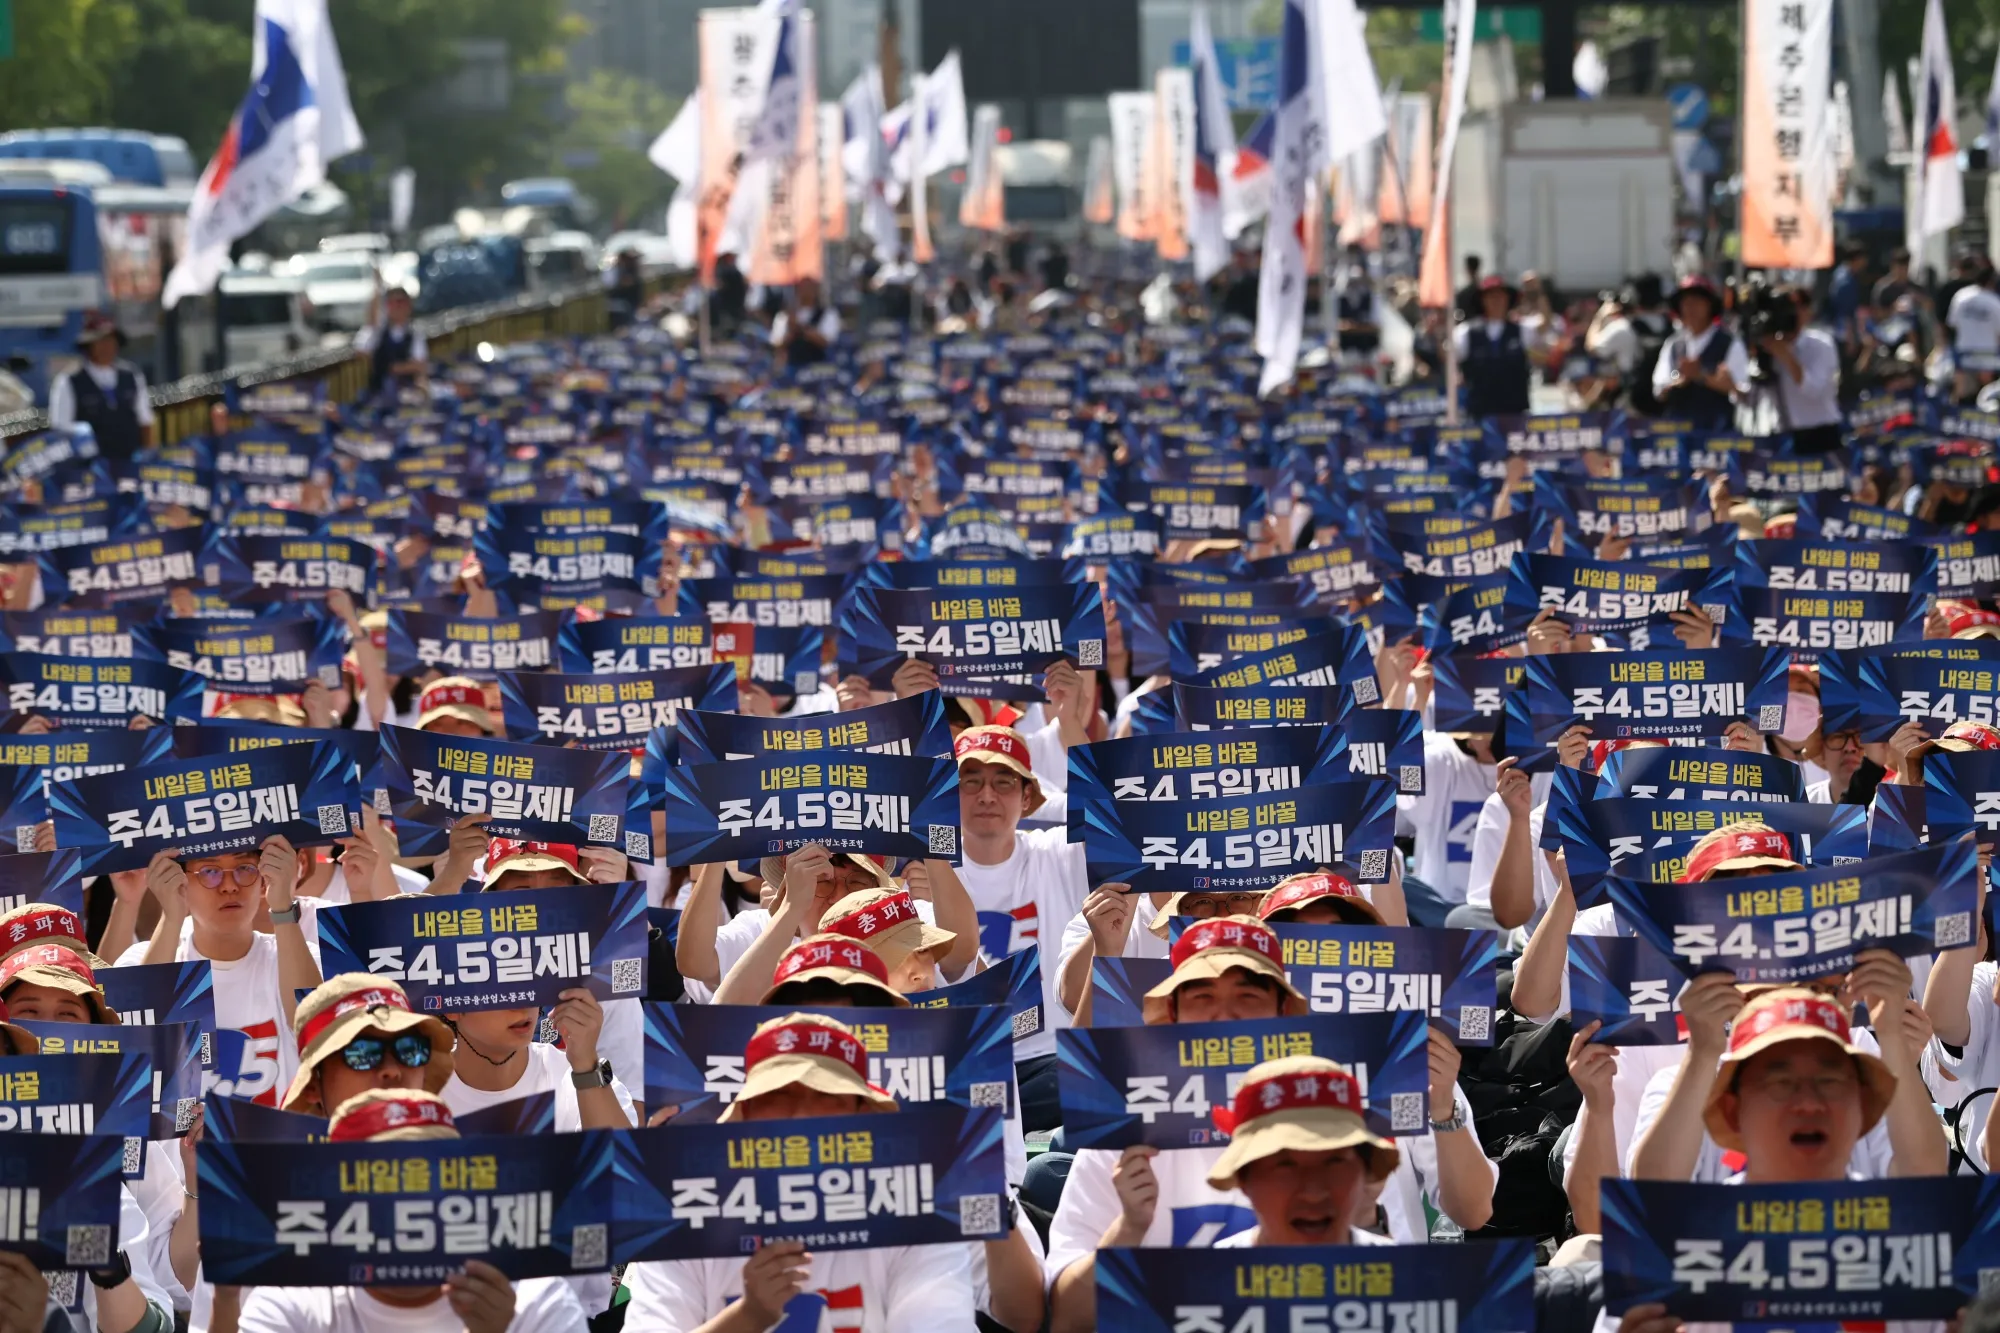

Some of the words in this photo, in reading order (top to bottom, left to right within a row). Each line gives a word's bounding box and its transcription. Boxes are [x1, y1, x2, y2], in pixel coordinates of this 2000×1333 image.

[69, 548, 195, 598] 주4.5일제!
[509, 550, 633, 581] 주4.5일제!
[1802, 550, 1847, 567] 내일을
[1850, 553, 1881, 569] 바꿀
[253, 560, 364, 596] 주4.5일제
[938, 569, 983, 584] 내일을
[987, 569, 1017, 584] 바꿀
[1574, 570, 1621, 589] 내일을
[1624, 576, 1657, 591] 바꿀
[733, 585, 773, 599] 내일을
[1537, 586, 1689, 619] 주4.5일제!
[931, 600, 984, 620] 내일을
[988, 598, 1022, 617] 바꿀
[1784, 600, 1829, 616] 내일을
[1833, 601, 1865, 617] 바꿀
[195, 641, 241, 655] 내일을
[244, 636, 274, 652] 바꿀
[447, 625, 489, 641] 내일을
[493, 624, 521, 639] 바꿀
[622, 627, 669, 644] 내일을
[673, 627, 704, 644] 바꿀
[896, 619, 1062, 658] 주4.5일제!
[1753, 618, 1893, 649] 주4.5일제!
[417, 635, 550, 669] 주4.5일제!
[1264, 654, 1297, 677] 바꿀
[42, 665, 93, 681] 내일을
[98, 667, 132, 682] 바꿀
[1610, 662, 1664, 681] 내일을
[1669, 661, 1705, 680] 바꿀
[1939, 671, 1992, 690] 내일을
[9, 683, 165, 722] 주4.5일제!
[565, 685, 616, 703] 내일을
[619, 681, 655, 700] 바꿀
[1573, 683, 1744, 720] 주4.5일제!
[1216, 699, 1271, 719] 내일을
[1276, 699, 1306, 718] 바꿀
[763, 730, 823, 750] 내일을
[828, 722, 869, 746] 바꿀
[1631, 724, 1703, 735] 전국금융산업노동조합
[55, 744, 89, 762] 바꿀
[438, 749, 488, 774] 내일을
[493, 756, 534, 779] 바꿀
[1153, 744, 1213, 768] 내일을
[1218, 742, 1258, 764] 바꿀
[145, 772, 206, 799] 내일을
[211, 764, 252, 788] 바꿀
[761, 765, 822, 790] 내일을
[829, 766, 868, 788] 바꿀
[1669, 761, 1728, 784] 내일을
[1733, 766, 1763, 787] 바꿀
[413, 769, 574, 822] 주4.5일제!
[108, 784, 298, 851] 주4.5일제!
[718, 791, 909, 837] 주4.5일제!
[1187, 808, 1249, 831] 내일을
[1255, 801, 1297, 825] 바꿀
[1652, 812, 1720, 833] 내일을
[1142, 822, 1343, 870] 주4.5일제!
[1736, 832, 1790, 853] 총파
[1651, 856, 1691, 883] 내일
[1727, 888, 1804, 916] 내일을
[1811, 878, 1860, 907] 바꿀
[9, 914, 77, 943] 총파업
[413, 909, 483, 936] 내일을
[490, 905, 538, 931] 바꿀
[1673, 895, 1914, 966] 주4.5일제!
[1195, 925, 1270, 954] 총파업
[1349, 942, 1395, 967] 바꿀
[366, 932, 591, 986] 주4.5일제!
[786, 944, 864, 975] 총파업
[443, 990, 537, 1007] 전국금융산업노동조합
[774, 1028, 859, 1065] 총파업
[1179, 1037, 1256, 1066] 내일을
[1263, 1033, 1313, 1062] 바꿀
[1259, 1076, 1352, 1108] 총파업
[728, 1137, 810, 1168] 내일을
[818, 1132, 873, 1162] 바꿀
[340, 1159, 430, 1192] 내일을
[439, 1156, 497, 1189] 바꿀
[672, 1164, 934, 1228] 주4.5일제!
[276, 1192, 552, 1255] 주4.5일제!
[1737, 1201, 1824, 1232] 내일을
[1834, 1198, 1891, 1229] 바꿀
[1673, 1233, 1952, 1293] 주4.5일제!
[1236, 1265, 1325, 1296] 내일을
[1335, 1264, 1393, 1295] 바꿀
